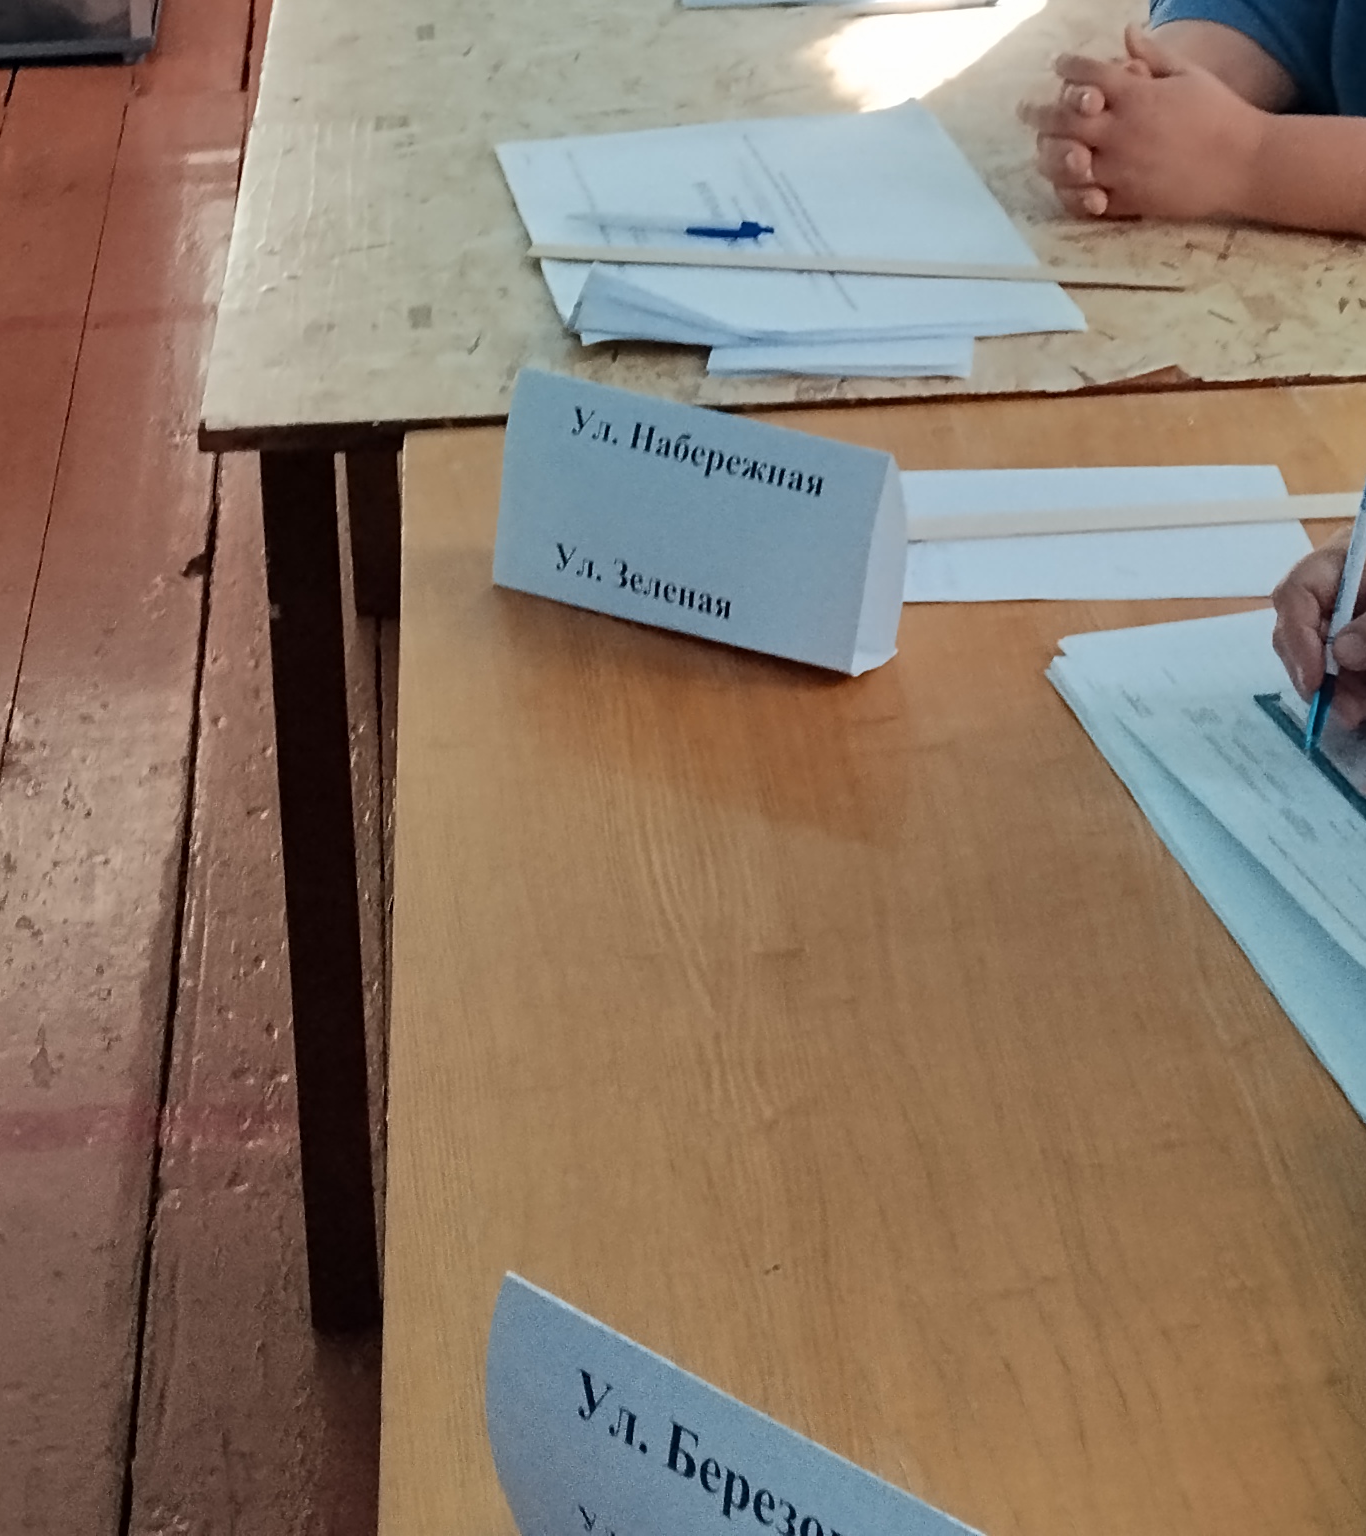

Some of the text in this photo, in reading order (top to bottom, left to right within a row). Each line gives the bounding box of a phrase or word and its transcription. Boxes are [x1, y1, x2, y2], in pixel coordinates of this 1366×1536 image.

[571, 406, 824, 497] Ул. Набережная
[556, 542, 732, 620] Ул. Зеленая
[577, 1368, 842, 1536] Ул. Березо
